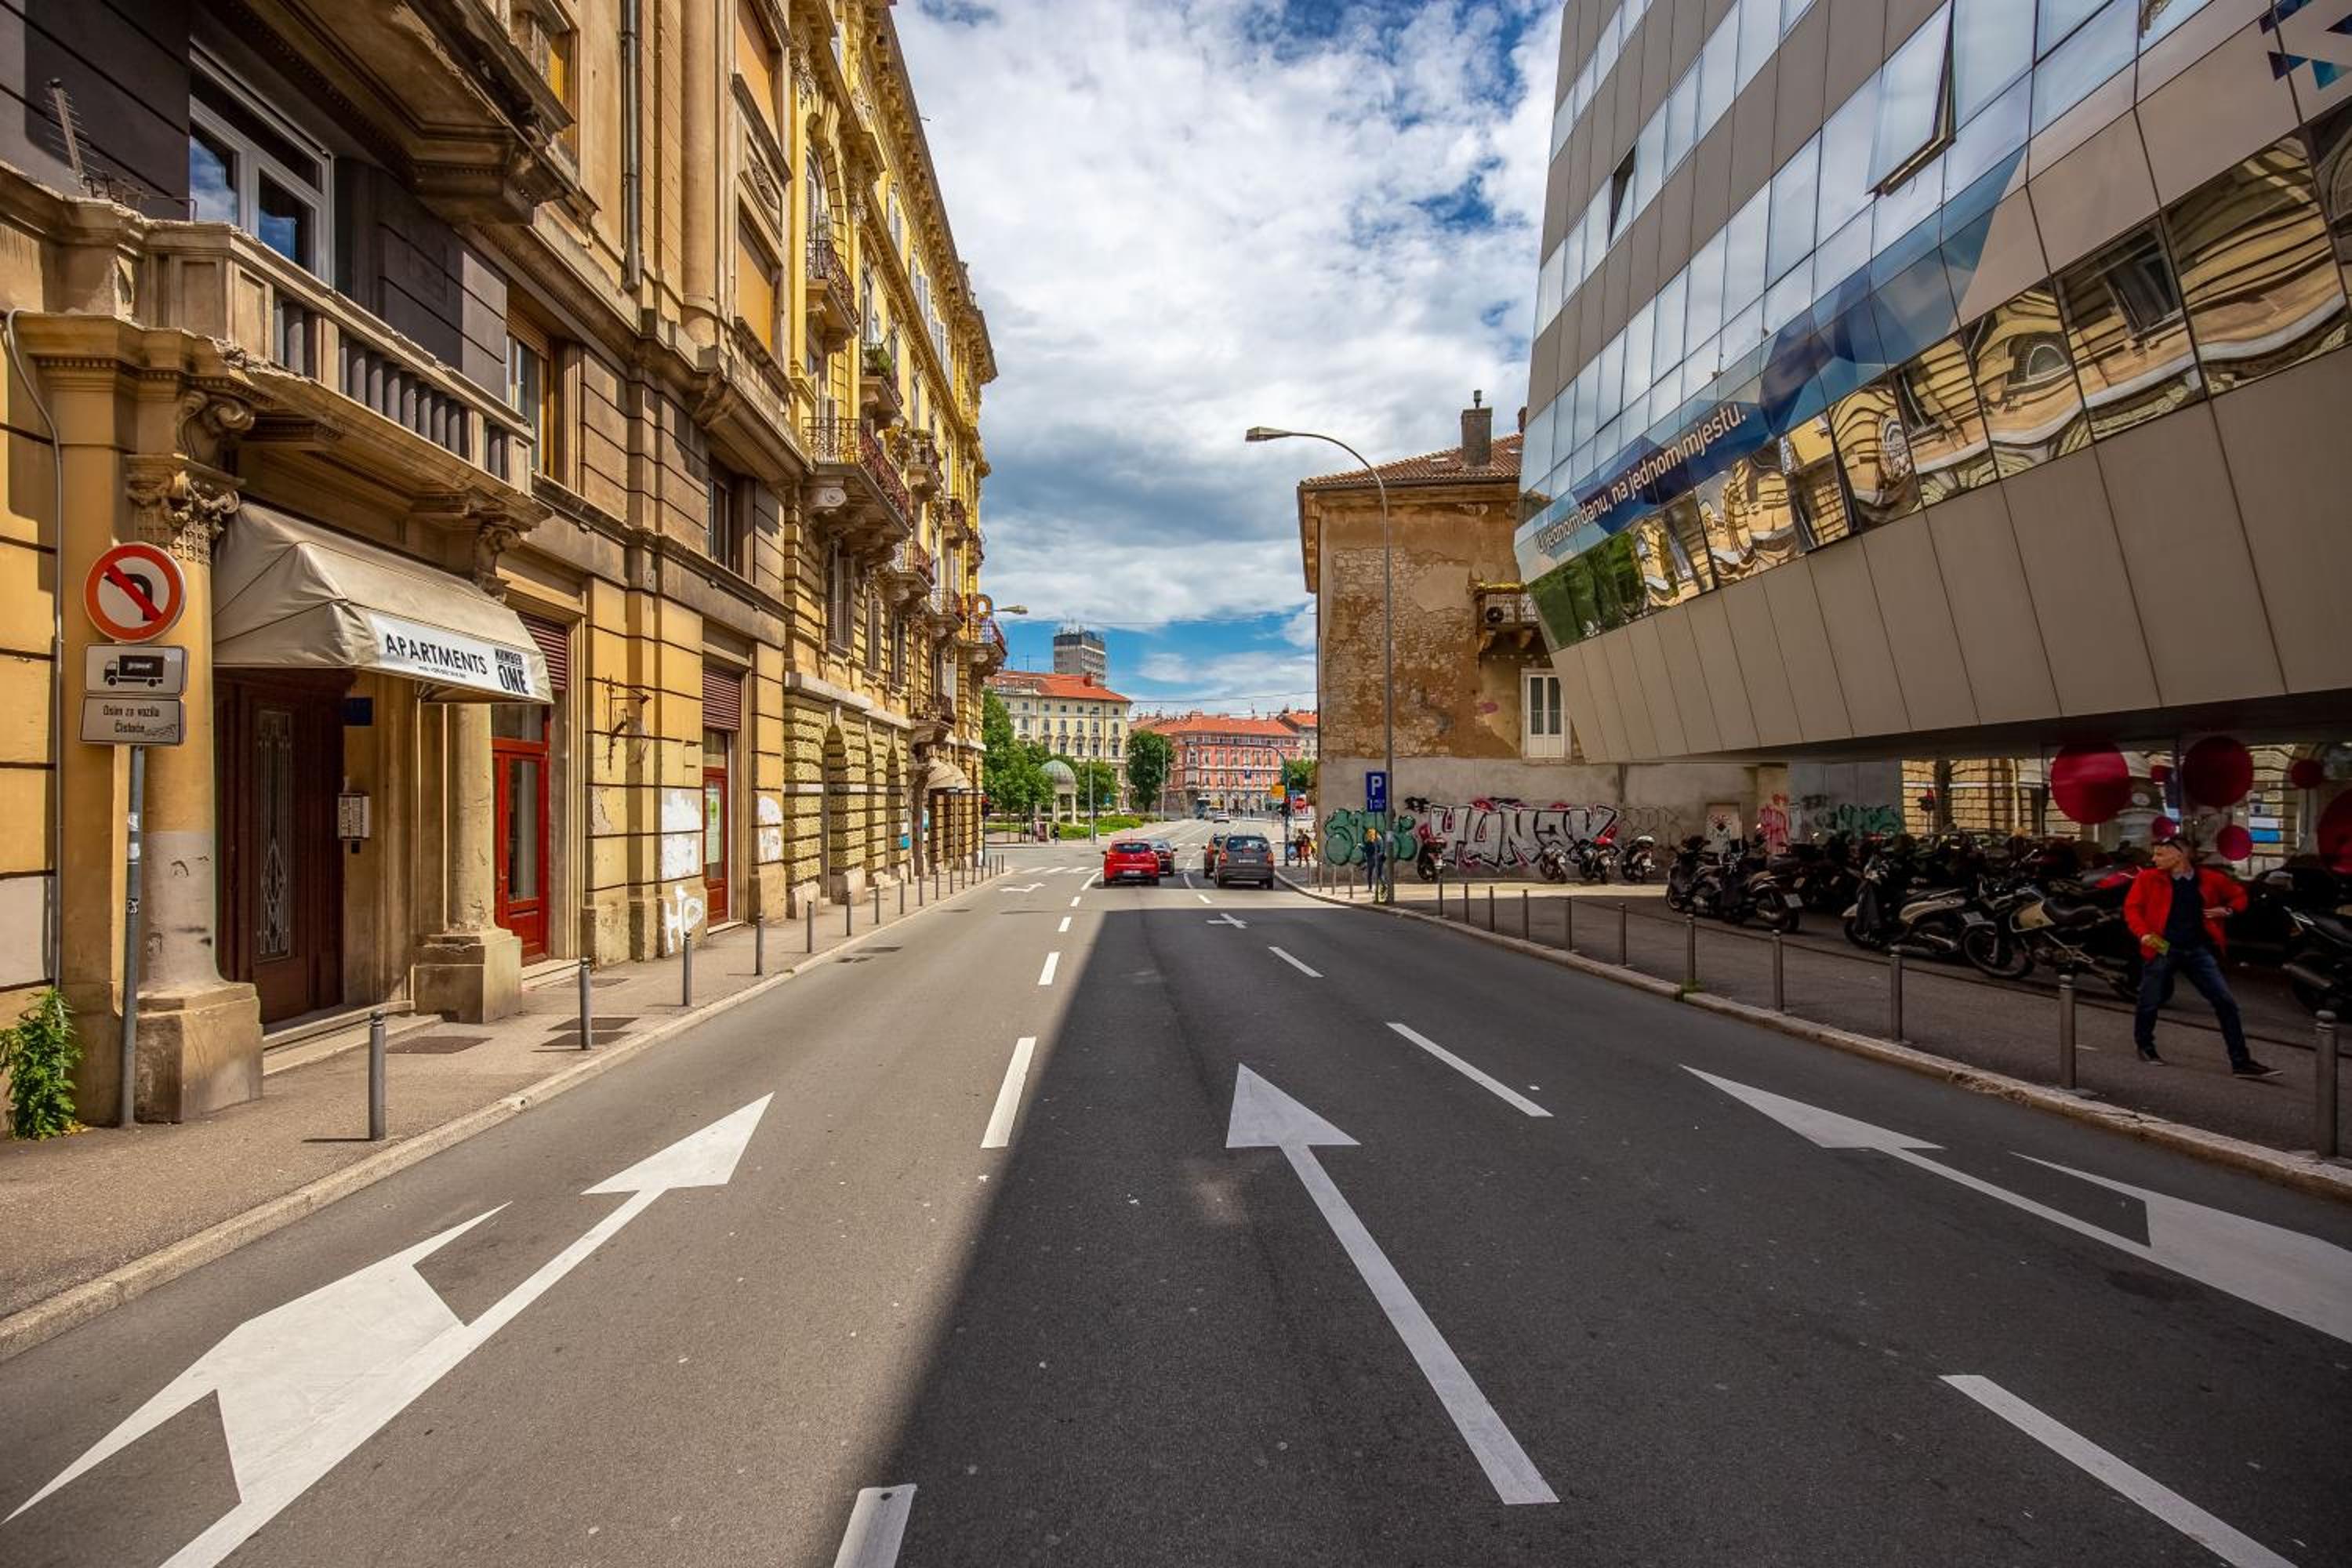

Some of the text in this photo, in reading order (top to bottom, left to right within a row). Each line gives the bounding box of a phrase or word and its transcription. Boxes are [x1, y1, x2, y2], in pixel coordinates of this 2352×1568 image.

[1581, 495, 1613, 524] danu,
[1612, 481, 1628, 506] na
[1627, 445, 1682, 500] jednom
[1682, 403, 1747, 458] mjestu.
[386, 632, 488, 675] APARTMENTS
[495, 648, 524, 666] NUMBER
[497, 664, 529, 695] ONE
[1371, 775, 1382, 796] P
